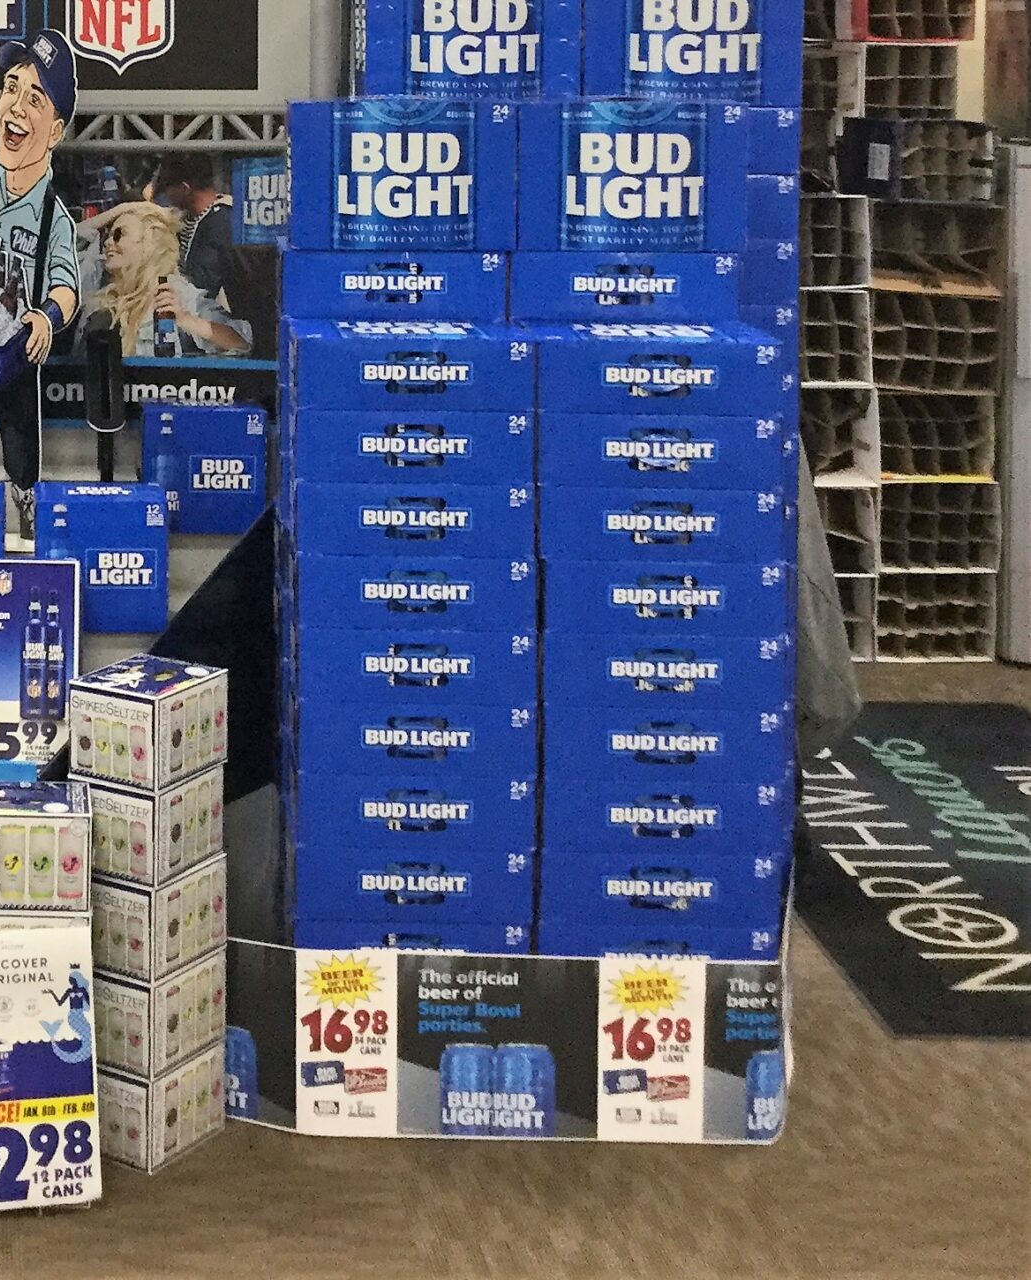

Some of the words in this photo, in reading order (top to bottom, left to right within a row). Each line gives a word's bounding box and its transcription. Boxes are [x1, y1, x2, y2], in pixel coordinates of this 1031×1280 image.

[411, 34, 539, 75] LIGHT
[629, 33, 761, 74] LIGHT
[352, 132, 460, 173] BUD
[580, 133, 691, 174] BUD
[338, 175, 472, 217] LIGHT
[566, 176, 704, 219] LIGHT
[344, 275, 385, 290] BUD
[387, 275, 444, 291] LIGHT
[47, 382, 85, 400] on
[202, 460, 244, 474] BUD
[193, 473, 251, 490] LIGHT
[99, 553, 144, 568] BUD
[90, 568, 152, 585] LIGHT
[32, 1172, 49, 1184] 12
[55, 1167, 93, 1181] PACK
[42, 1183, 83, 1198] CANS
